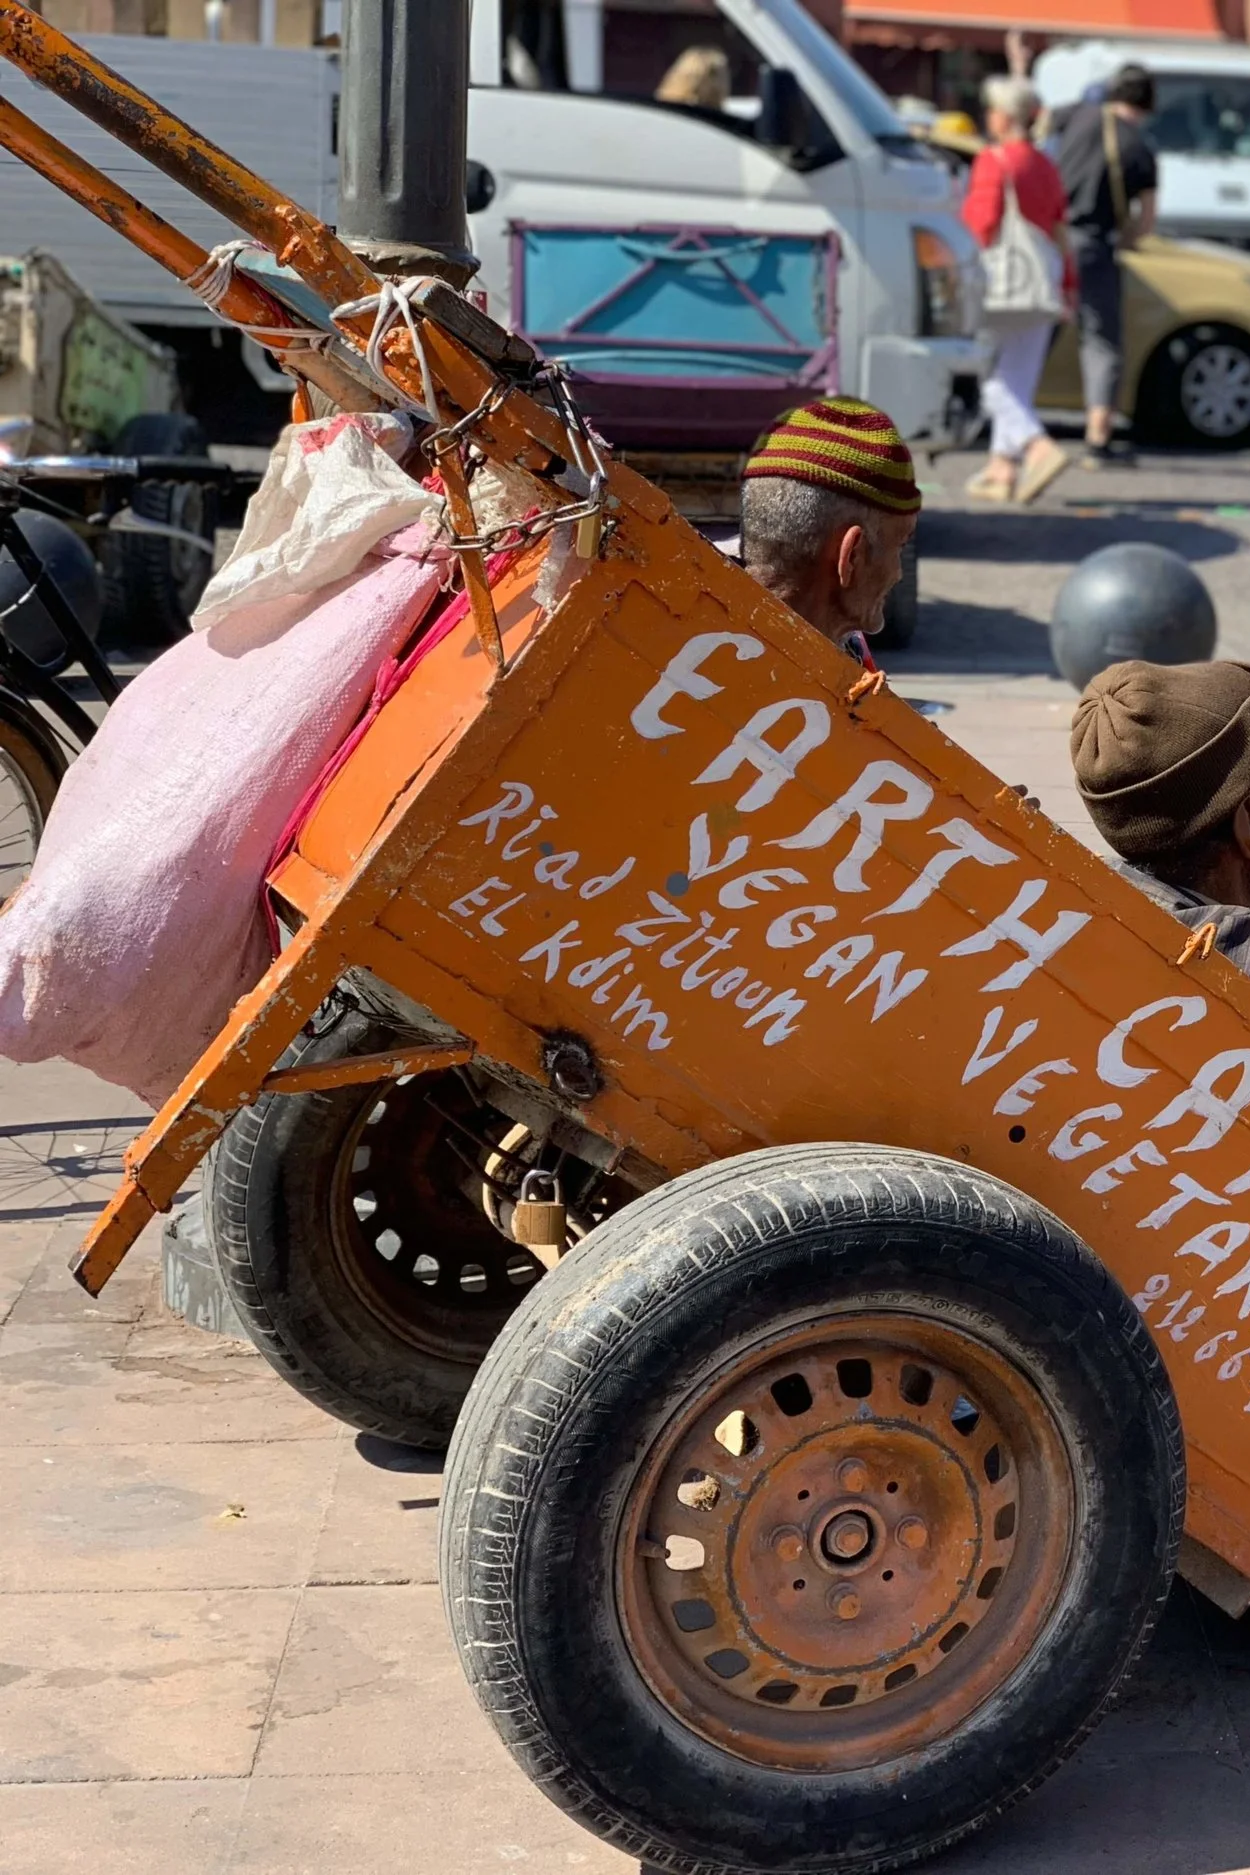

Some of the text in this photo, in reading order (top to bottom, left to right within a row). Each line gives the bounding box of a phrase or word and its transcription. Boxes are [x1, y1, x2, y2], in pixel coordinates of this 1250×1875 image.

[458, 781, 807, 1046] Riad Zitoun
[630, 631, 1092, 993] EARTH
[687, 813, 930, 1022] VEGAN
[448, 876, 674, 1051] EL Kdim
